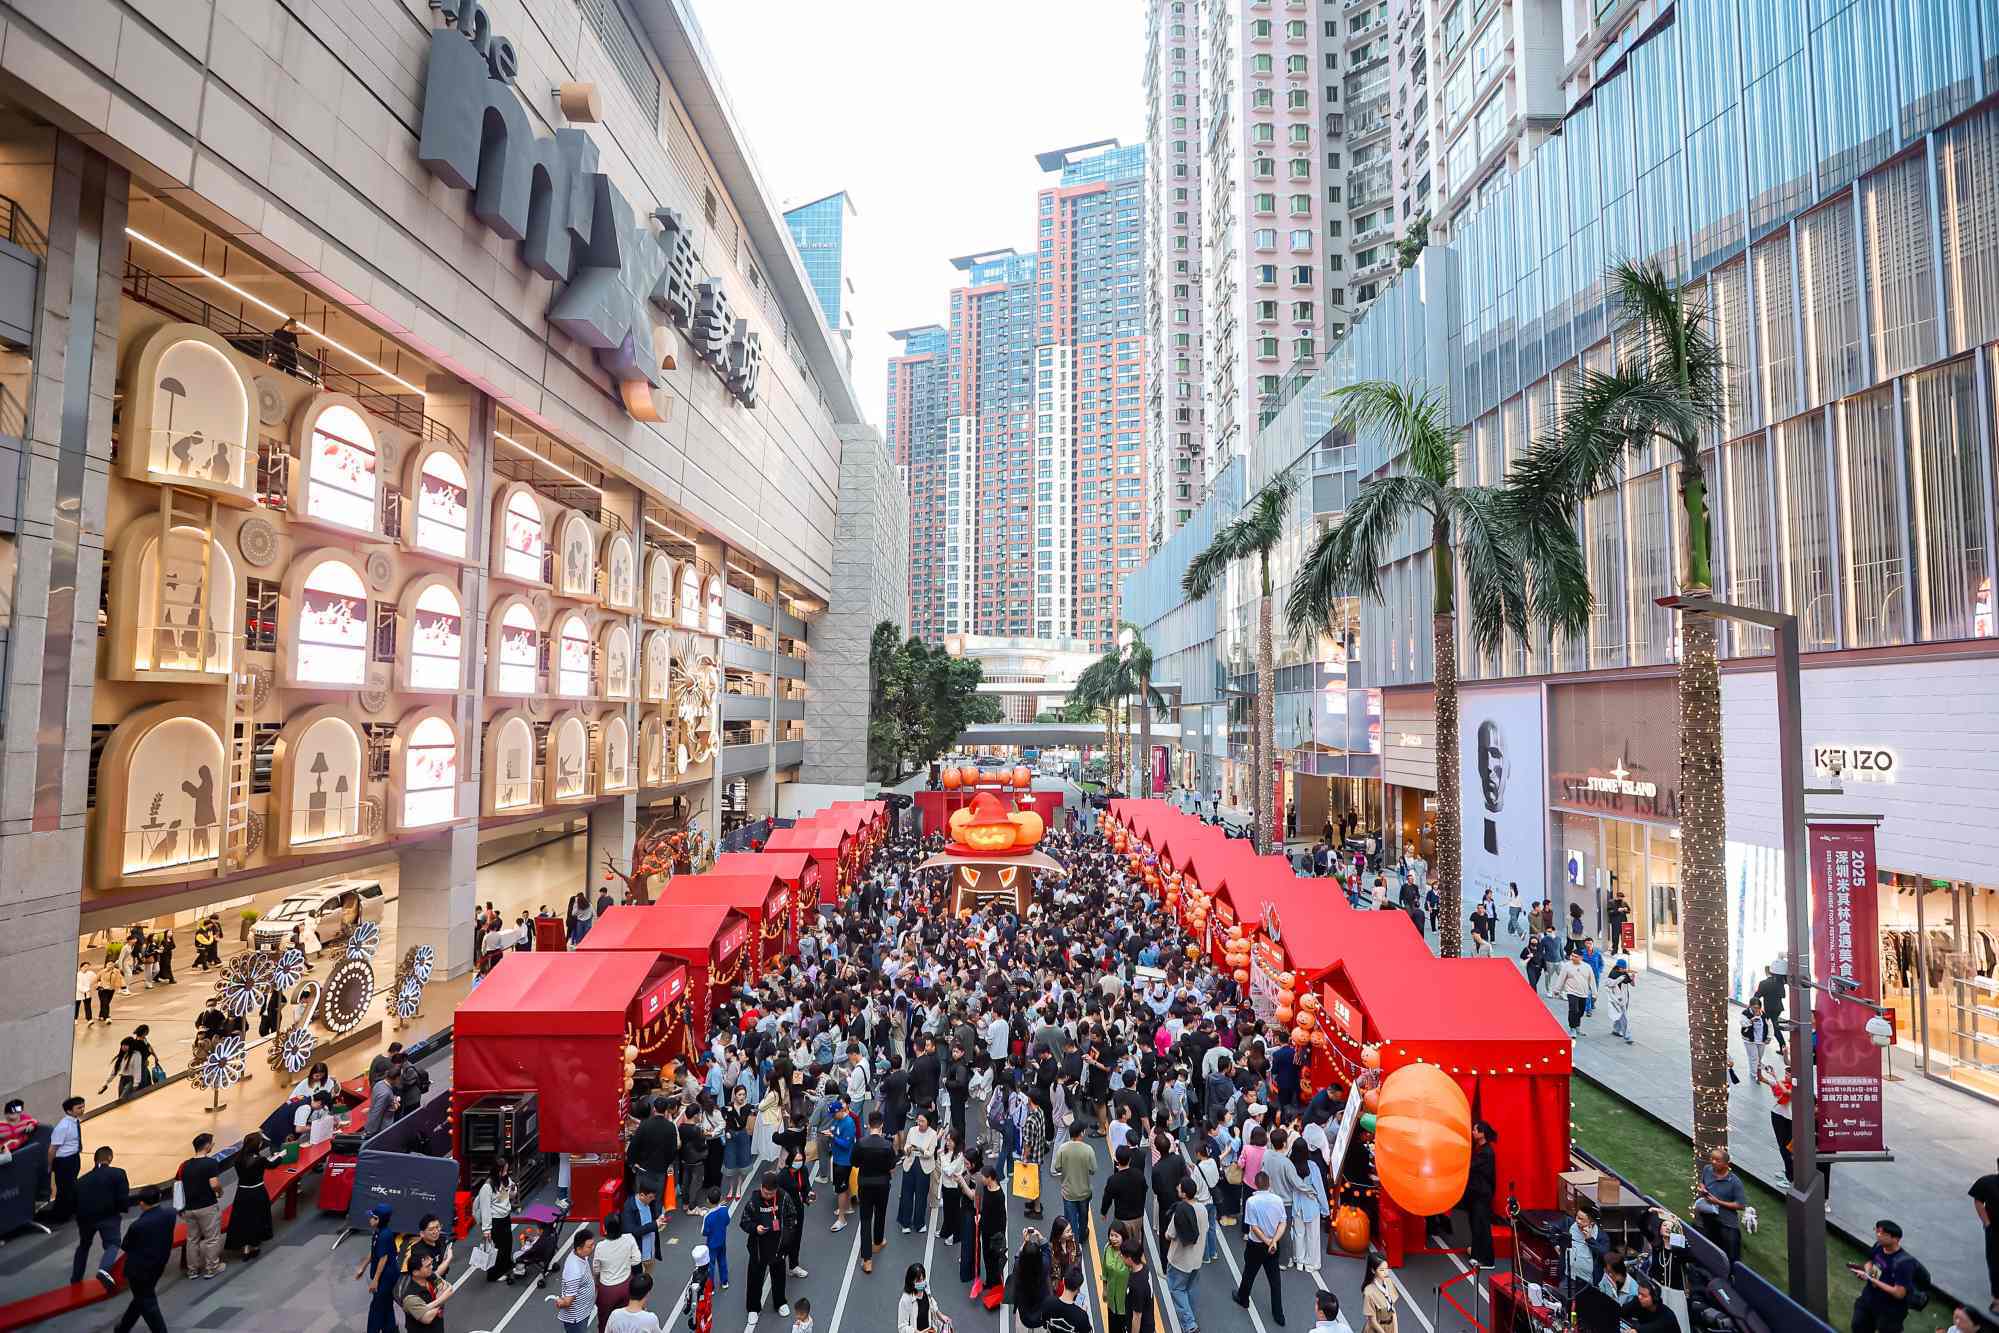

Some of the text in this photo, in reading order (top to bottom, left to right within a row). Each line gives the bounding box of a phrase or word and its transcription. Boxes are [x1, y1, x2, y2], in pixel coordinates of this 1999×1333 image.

[1588, 777, 1657, 798] STONE ISLAND
[1852, 850, 1866, 887] 2025
[1835, 850, 1854, 980] 深圳米其林食遇美食
